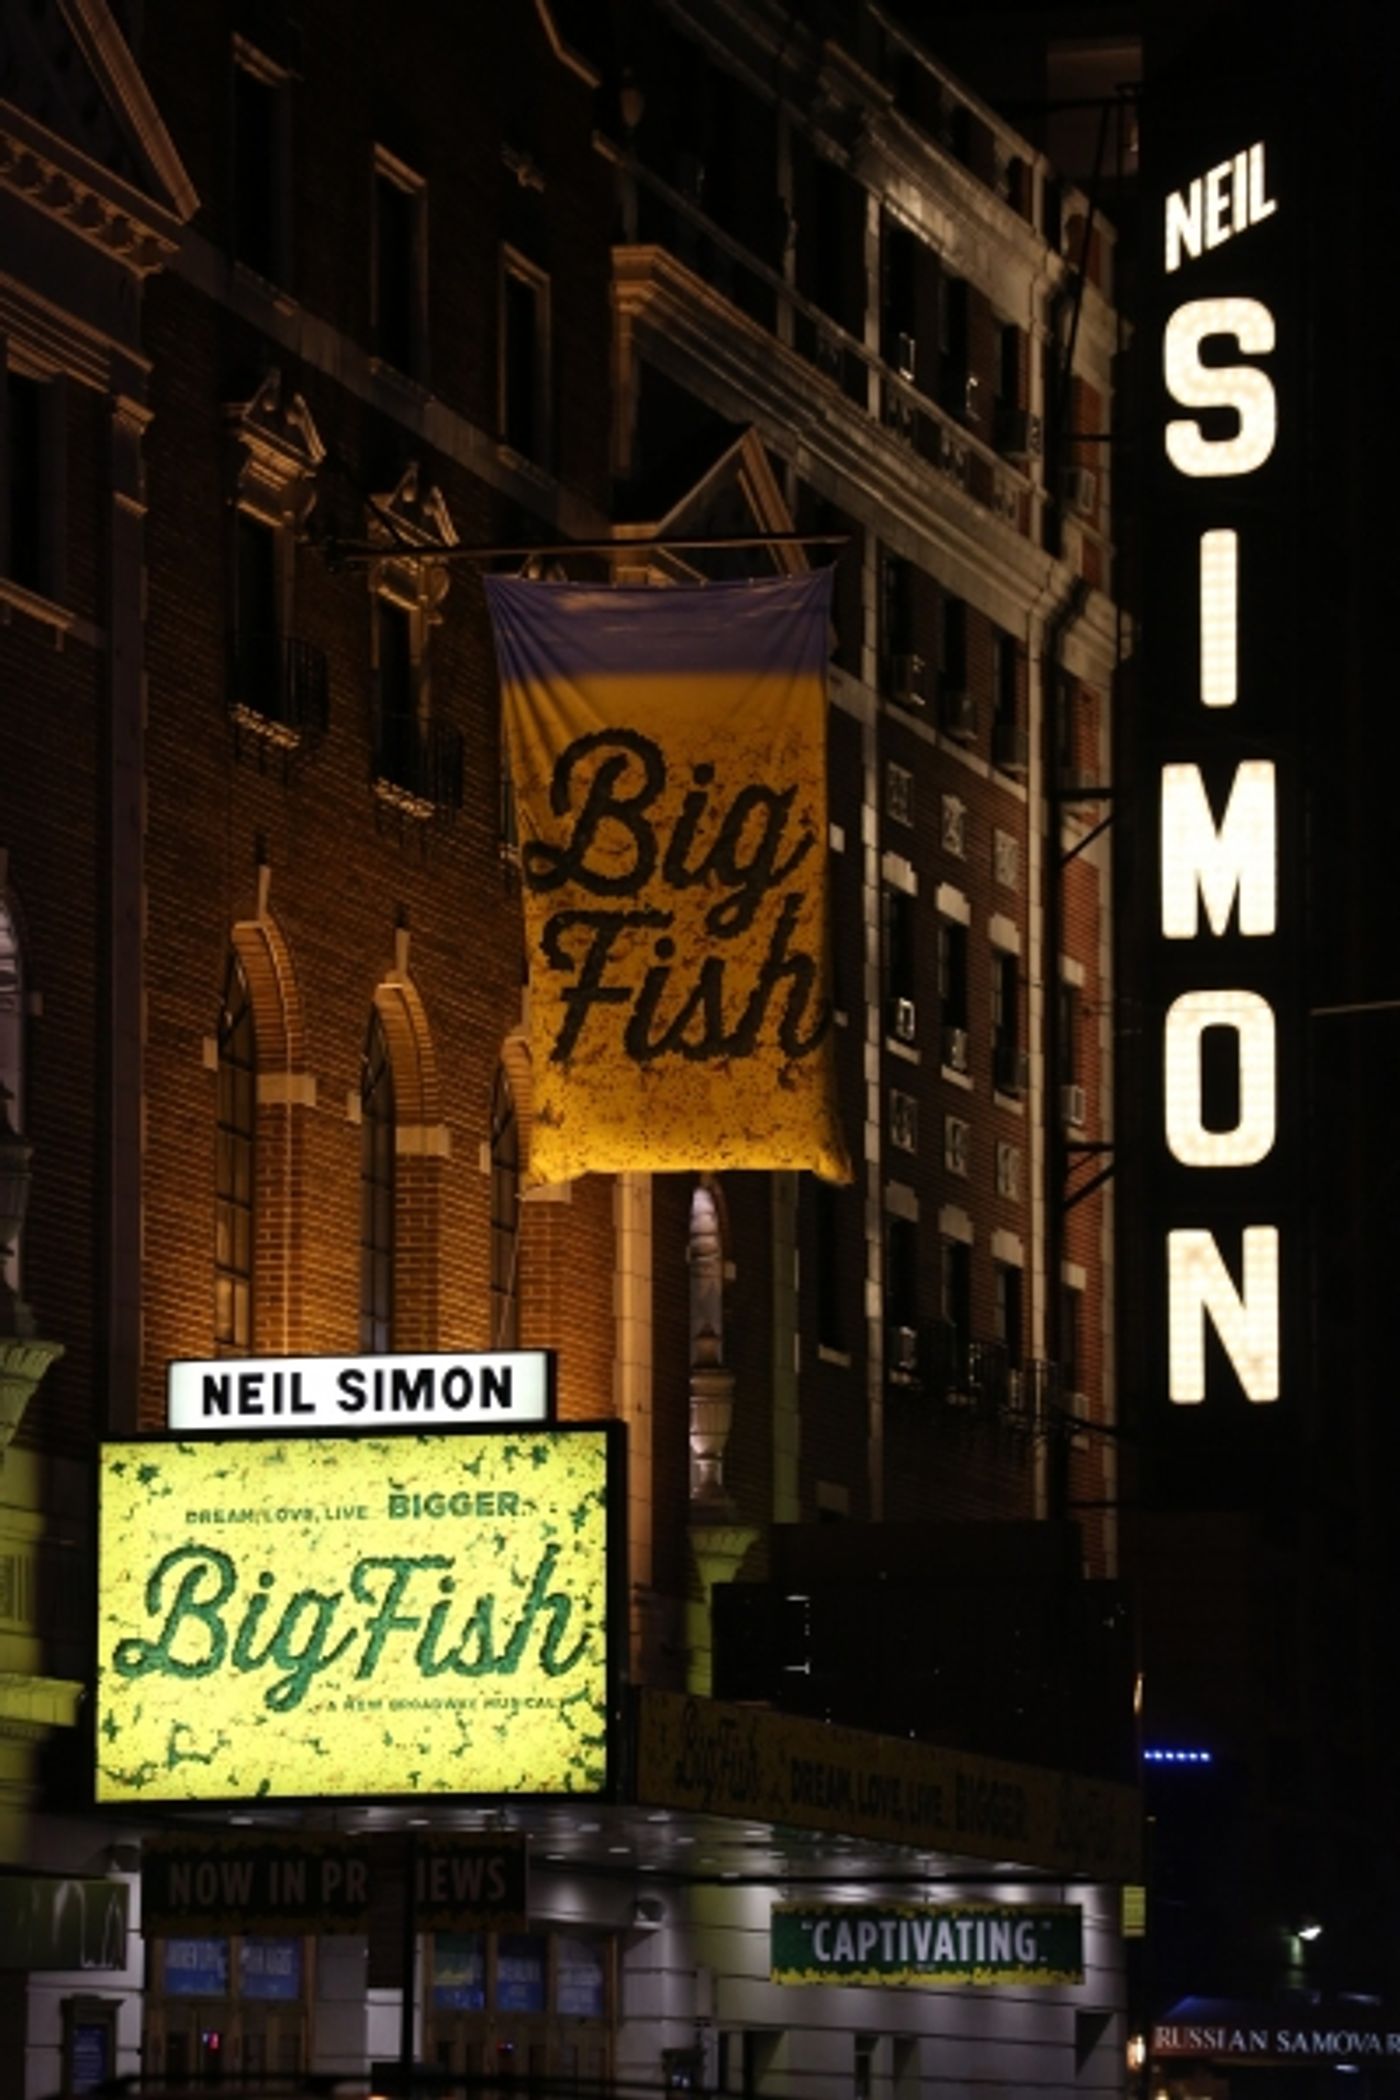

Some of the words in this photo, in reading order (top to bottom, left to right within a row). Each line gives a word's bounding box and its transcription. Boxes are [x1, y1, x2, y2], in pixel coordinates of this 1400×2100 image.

[1165, 141, 1277, 272] NEIL
[524, 728, 817, 938] Big
[1162, 297, 1279, 1404] SIMON
[540, 893, 831, 1063] Fish
[202, 1370, 316, 1416] NEIL
[336, 1365, 513, 1413] SIMON
[112, 1544, 358, 1712] Big
[350, 1542, 590, 1679] Fish
[169, 1860, 254, 1906] NOW
[269, 1858, 307, 1905] IN
[1154, 2026, 1267, 2051] RUSSIAN
[1276, 2030, 1400, 2055] SAMOVAR
